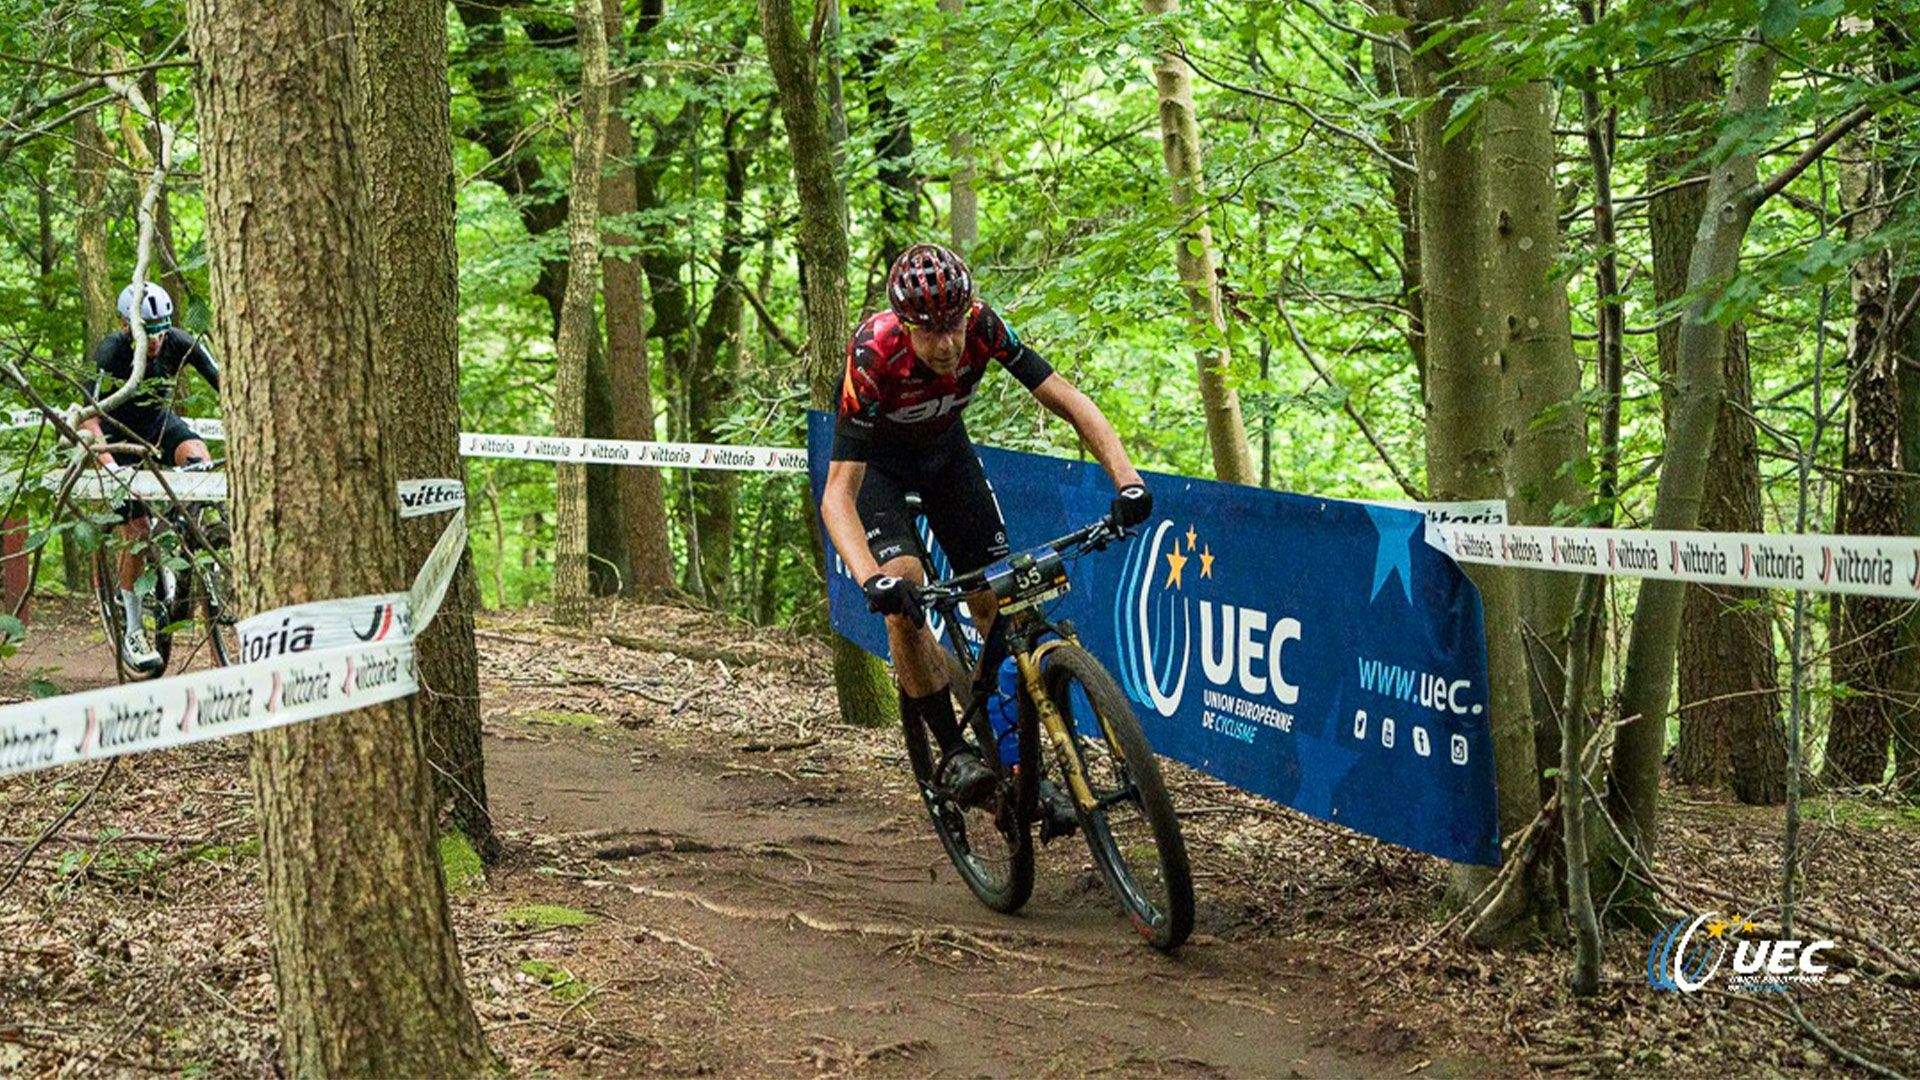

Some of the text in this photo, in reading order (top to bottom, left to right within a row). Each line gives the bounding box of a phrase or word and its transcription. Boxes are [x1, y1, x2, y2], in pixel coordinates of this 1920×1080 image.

[535, 441, 571, 457] vittoria
[590, 444, 629, 460] vittoria
[651, 446, 691, 464] vittoria
[712, 449, 755, 467] vittoria
[778, 453, 808, 469] vitto
[1507, 534, 1544, 563] vittoria
[1559, 536, 1598, 567] vittoria
[1616, 538, 1659, 571] vittoria
[1680, 541, 1728, 576] vittoria
[1752, 544, 1805, 580] vittoria
[1834, 547, 1893, 586] vittoria
[1016, 566, 1042, 589] 55
[1200, 601, 1301, 705] UEC
[1203, 689, 1235, 714] UNION
[1202, 711, 1216, 730] DE
